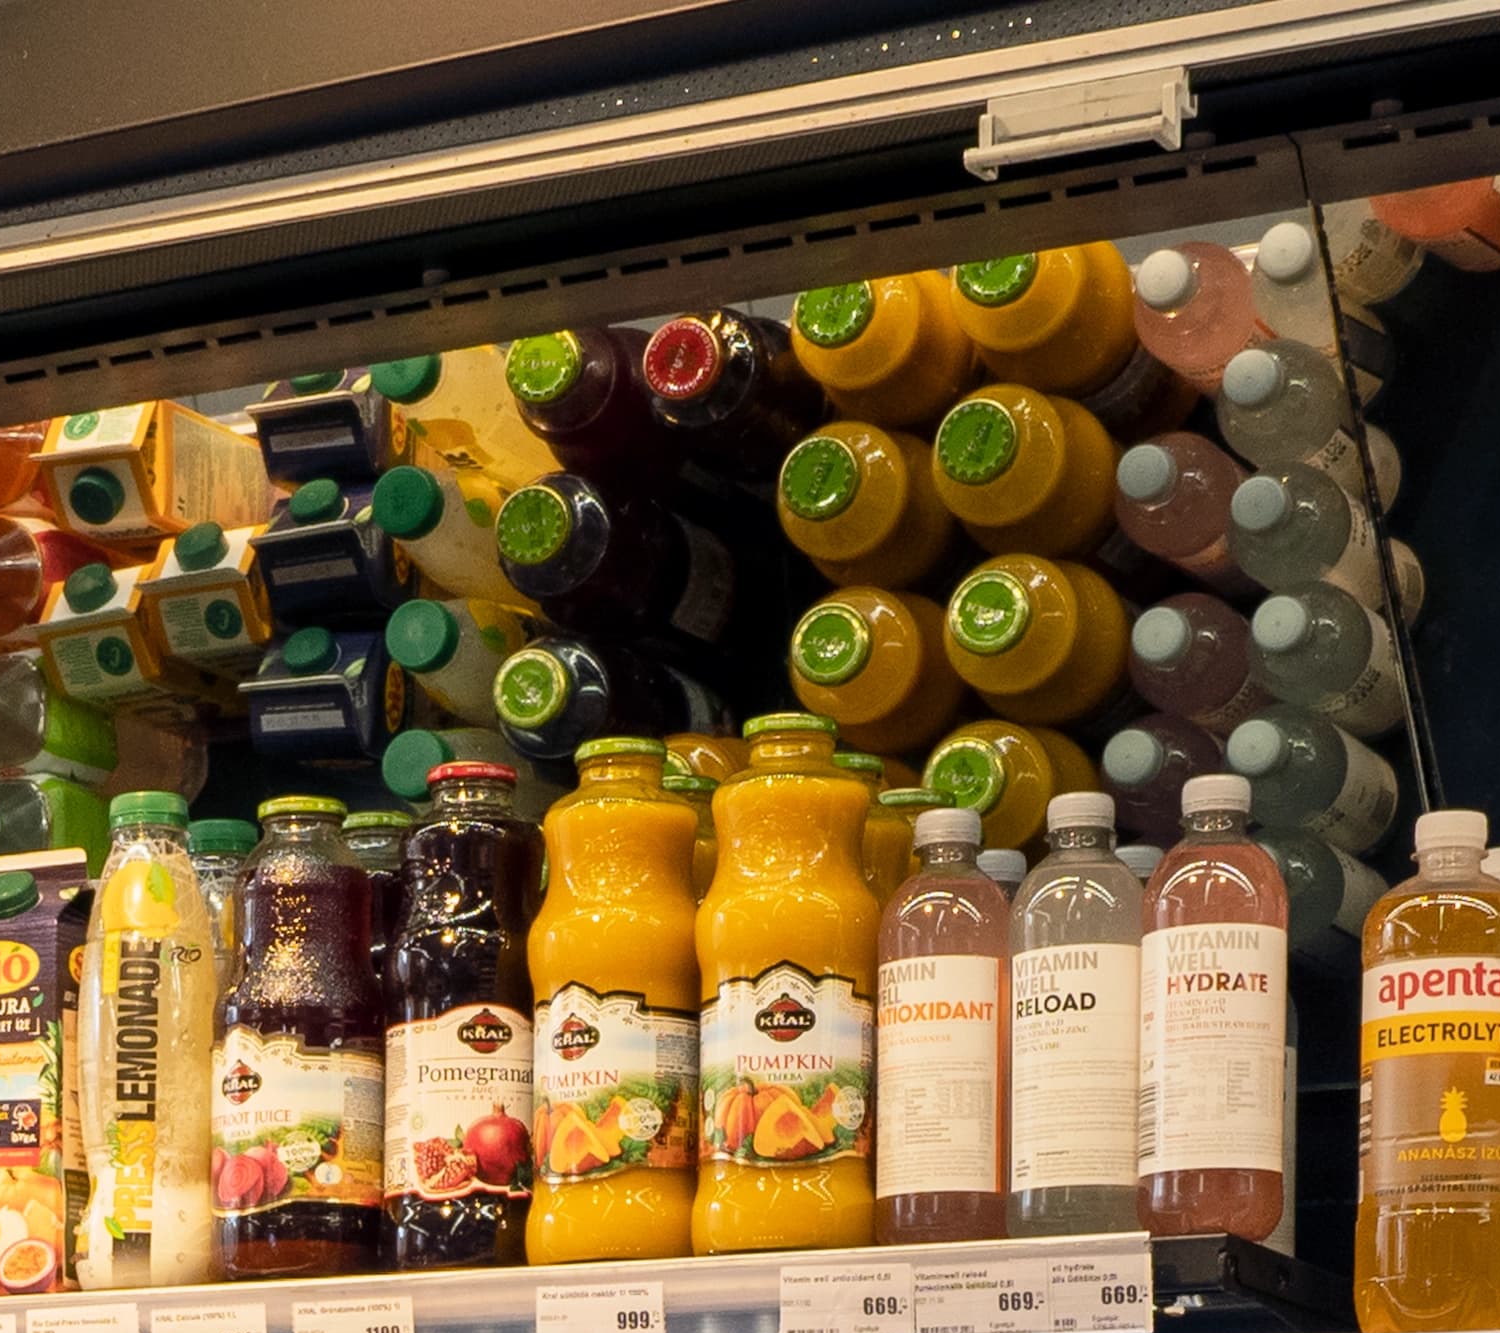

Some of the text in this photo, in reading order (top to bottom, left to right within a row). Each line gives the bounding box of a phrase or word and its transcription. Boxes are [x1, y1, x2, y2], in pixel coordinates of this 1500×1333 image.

[1166, 931, 1261, 952] VITAMIN
[1014, 950, 1100, 978] VITAMIN
[1167, 951, 1222, 972] WELL
[1014, 973, 1060, 1000] WELL
[1167, 972, 1269, 995] HYDRATE
[1015, 992, 1097, 1020] RELOAD
[116, 938, 161, 1121] LEMONADE
[737, 1055, 834, 1072] PUMPKIN
